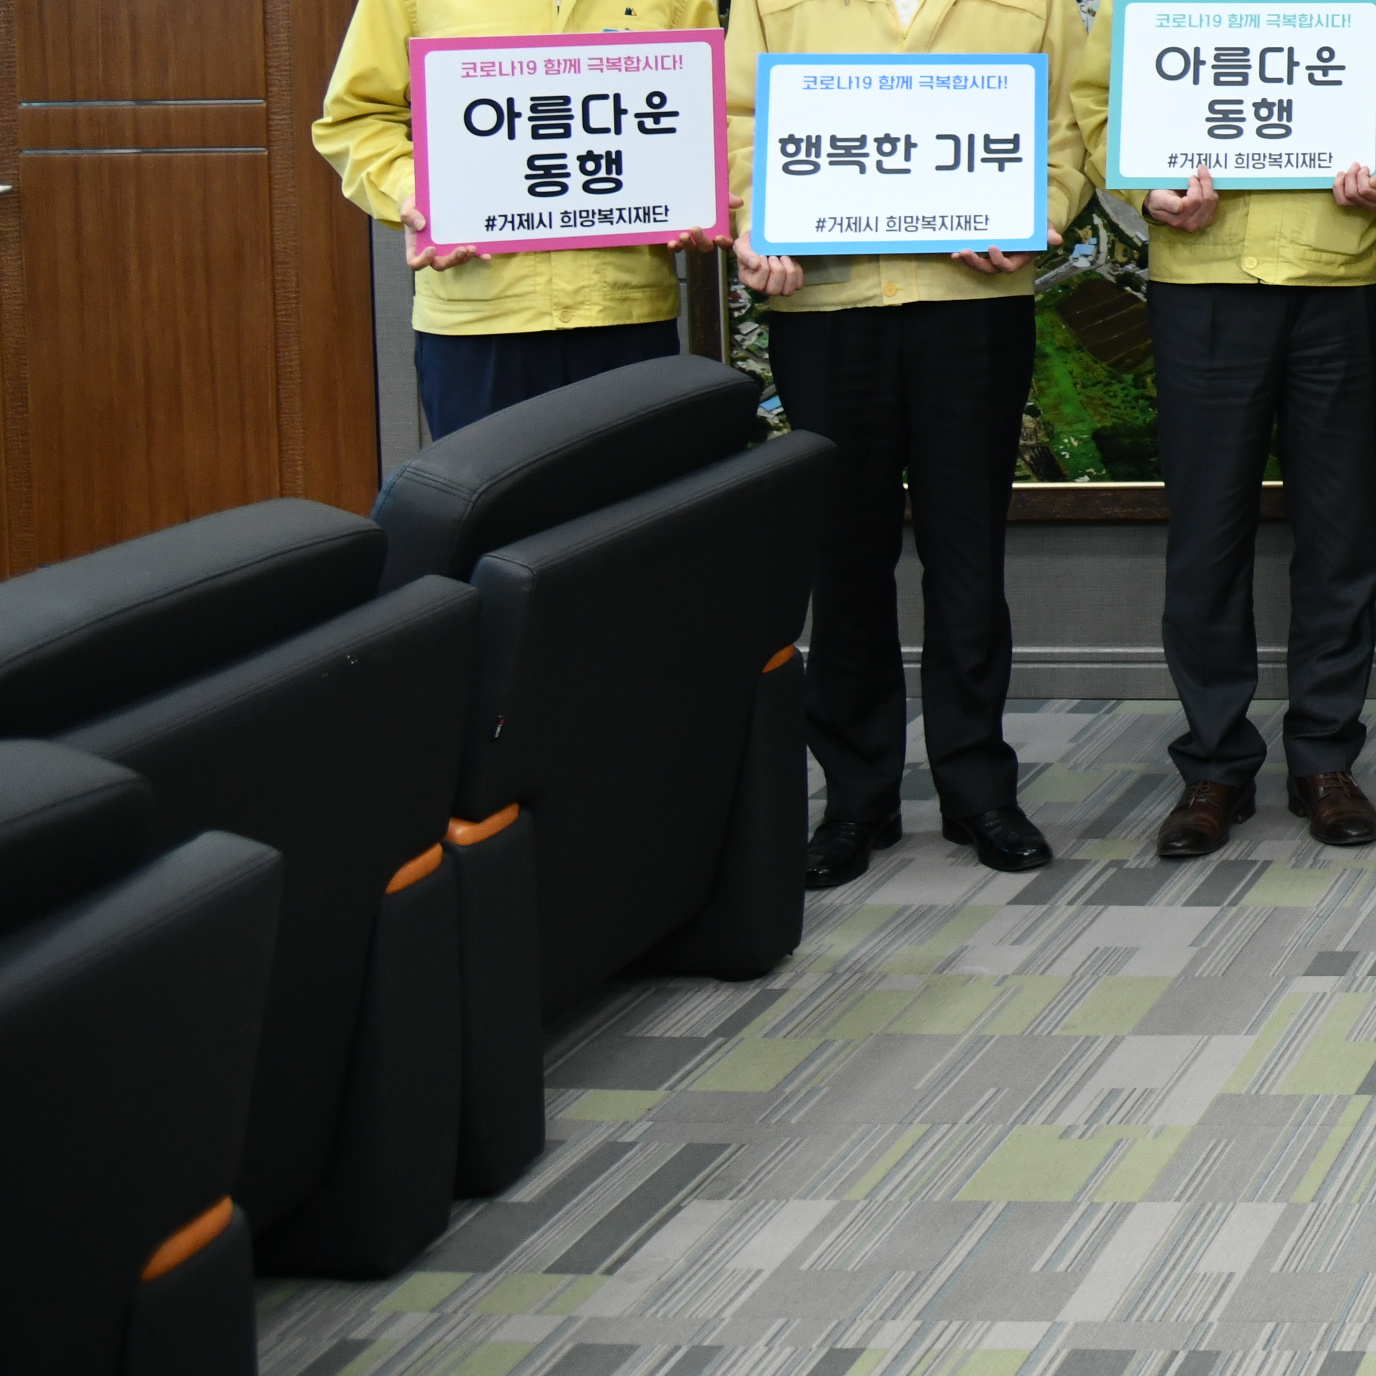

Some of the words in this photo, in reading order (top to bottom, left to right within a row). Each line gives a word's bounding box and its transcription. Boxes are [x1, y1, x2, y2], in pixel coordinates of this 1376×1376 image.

[1155, 13, 1223, 29] 코로나19
[1227, 13, 1261, 29] 함께
[1265, 13, 1352, 29] 극복합시다!
[460, 59, 538, 79] 코로나19
[543, 57, 582, 76] 함께
[587, 54, 683, 74] 극복합시다!
[1155, 45, 1347, 87] 아름다운
[802, 75, 873, 90] 코로나19
[878, 74, 913, 91] 함께
[918, 74, 1008, 90] 극복합시다!
[463, 90, 680, 141] 아름다운
[1204, 97, 1293, 140] 동행
[778, 132, 919, 176] 행복한
[934, 133, 1024, 173] 기부
[1167, 152, 1228, 169] #거제시
[1234, 151, 1334, 170] 희망복지재단
[524, 149, 624, 198] 동행
[484, 211, 553, 232] #거제시
[560, 205, 670, 228] 희망복지재단
[815, 215, 879, 234] #거제시
[885, 214, 990, 233] 희망복지재단
